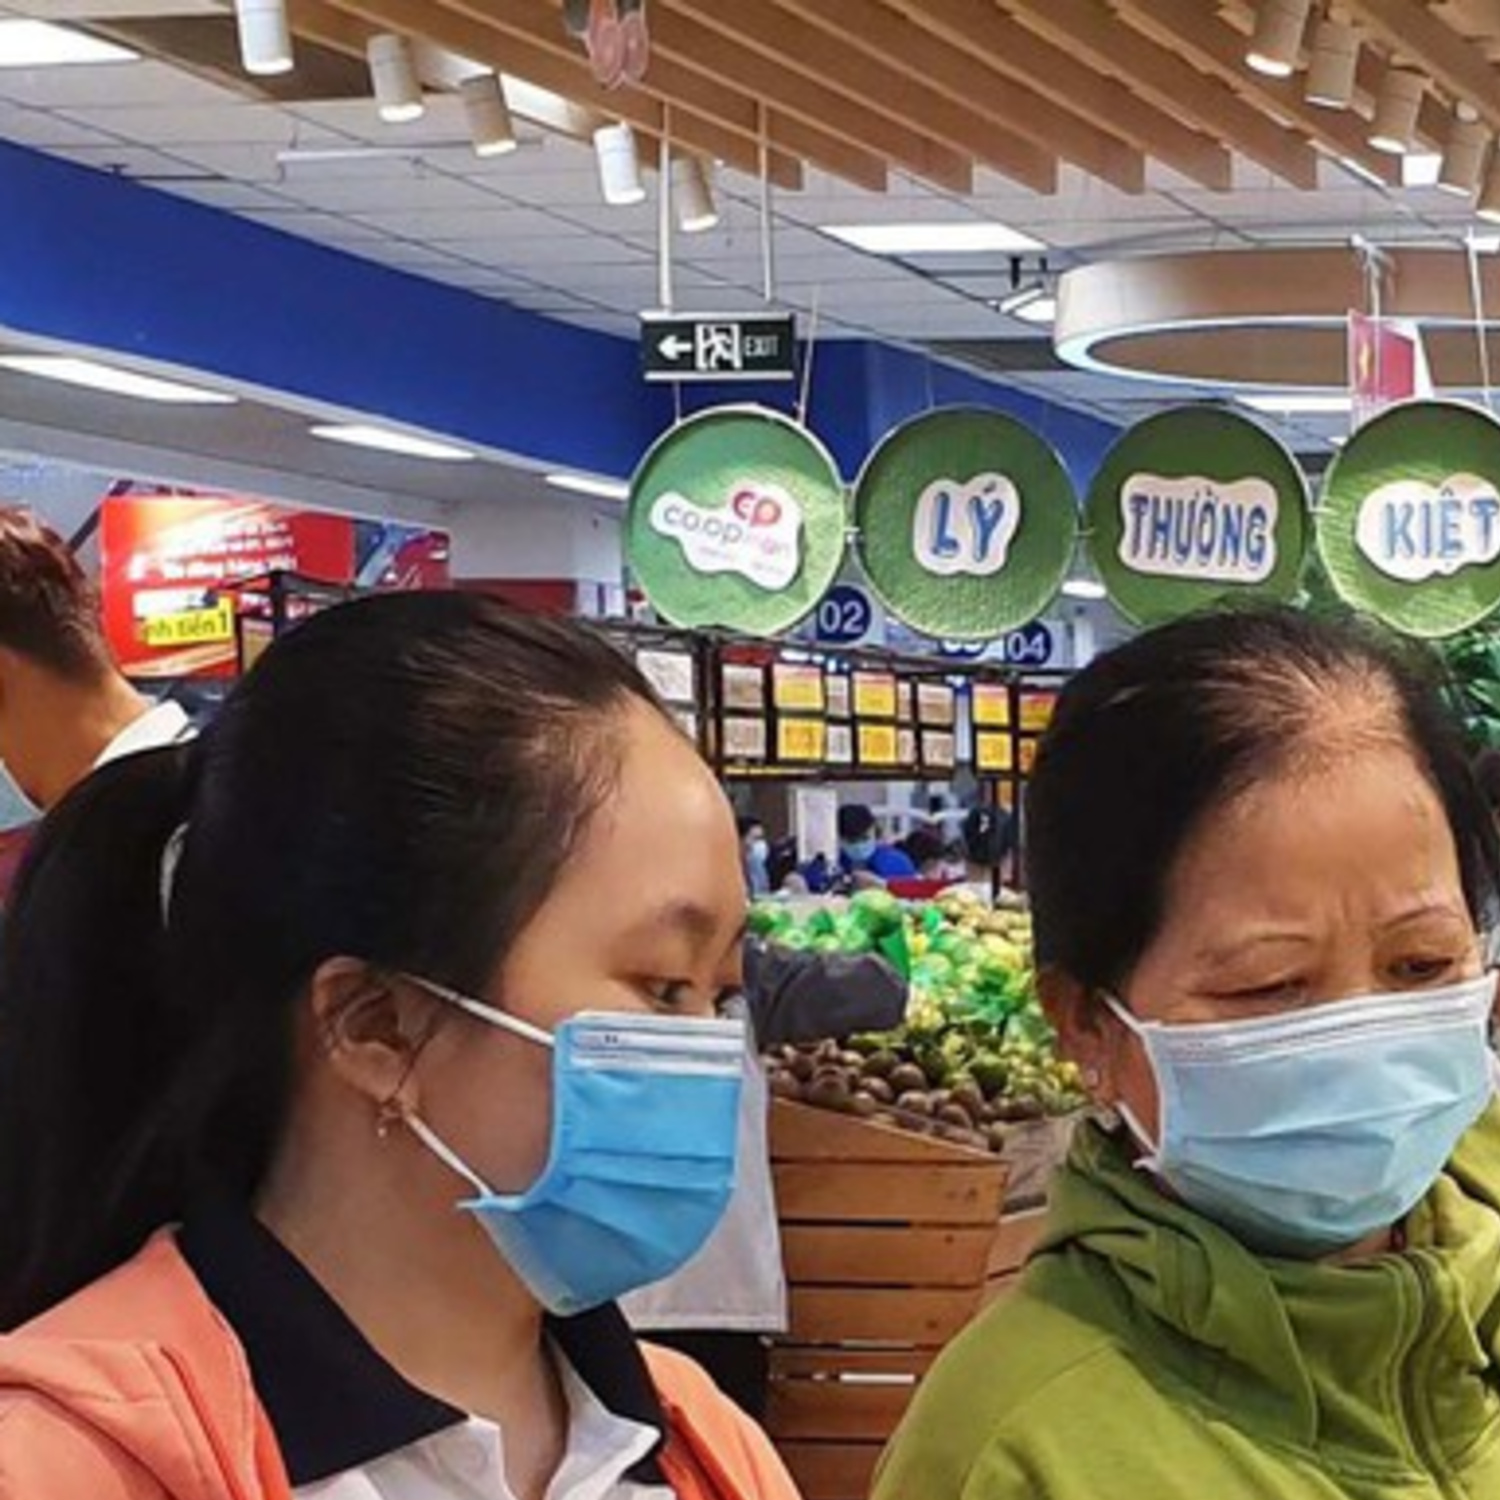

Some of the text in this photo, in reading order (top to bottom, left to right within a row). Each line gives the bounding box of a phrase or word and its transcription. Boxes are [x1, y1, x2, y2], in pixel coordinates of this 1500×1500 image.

[744, 334, 780, 357] EXIT
[930, 480, 1004, 563] LÝ
[1127, 485, 1268, 571] THƯỜNG
[819, 600, 865, 635] 02
[1007, 632, 1046, 662] 04
